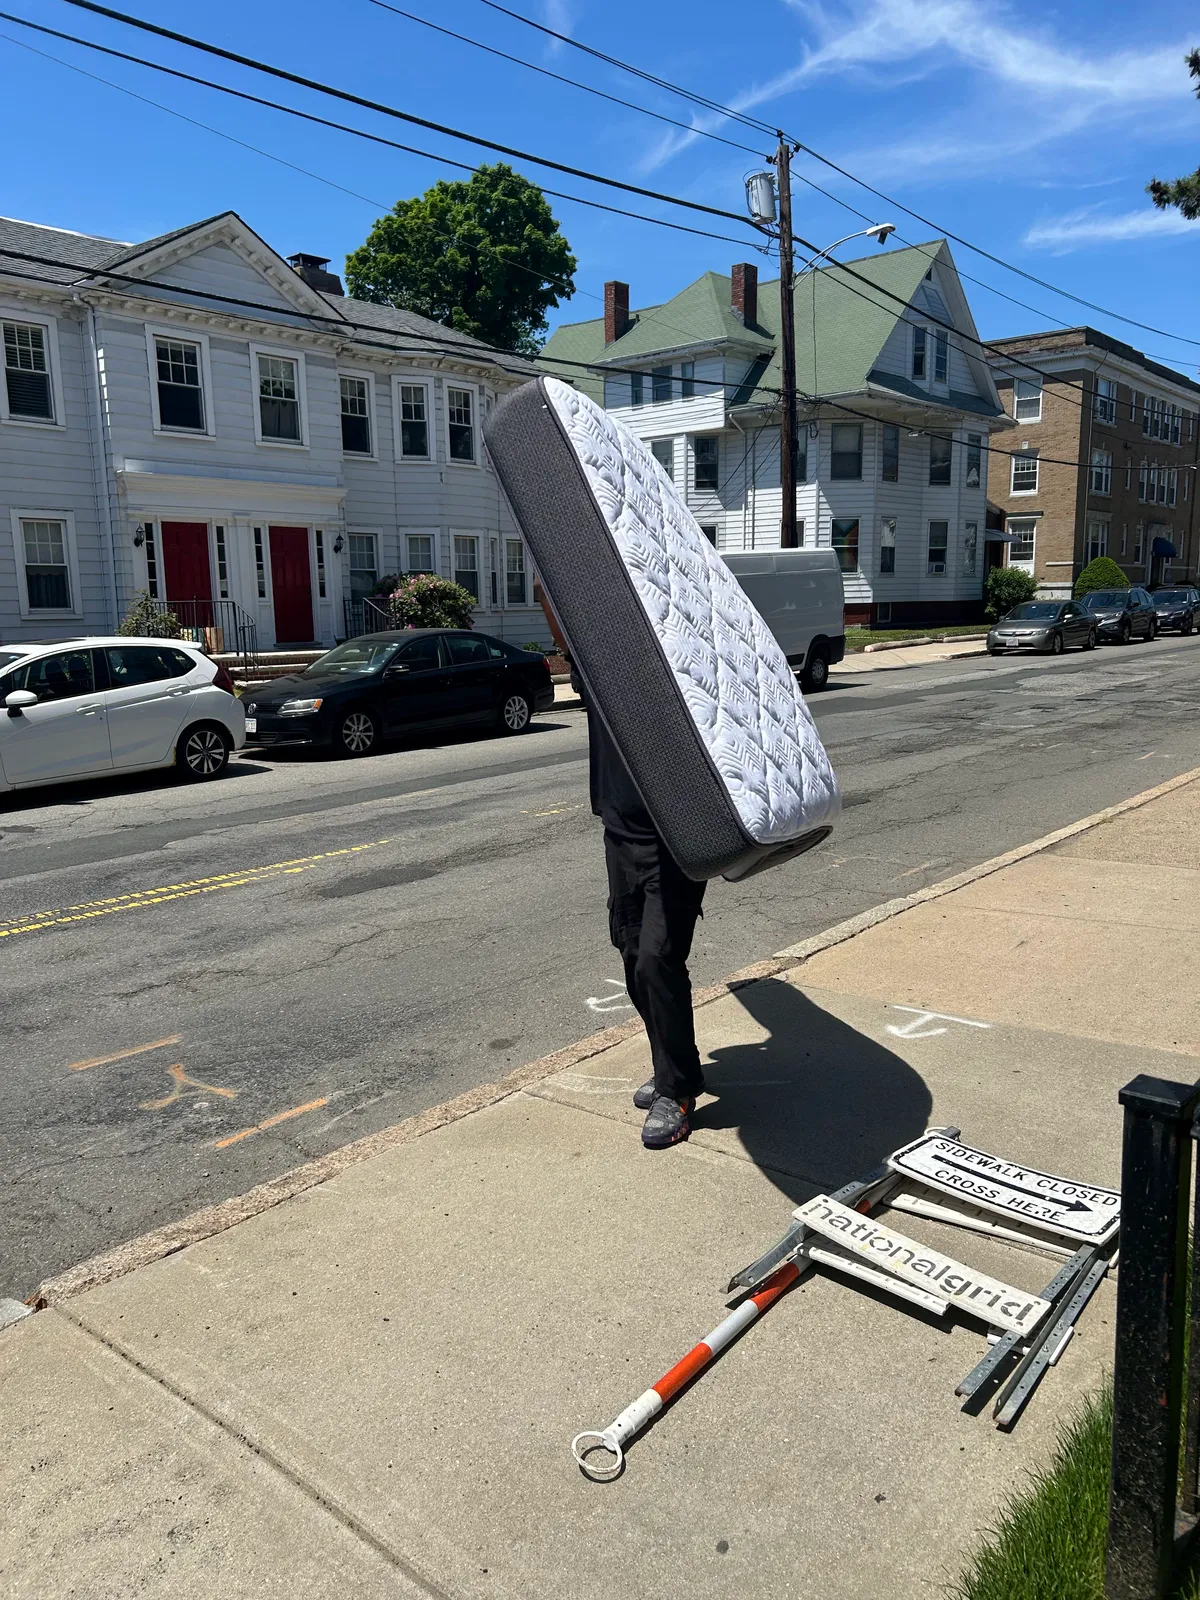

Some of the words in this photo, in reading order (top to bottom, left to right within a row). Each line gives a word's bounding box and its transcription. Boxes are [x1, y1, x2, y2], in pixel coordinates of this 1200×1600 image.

[935, 1169, 1000, 1199] CROSS
[1007, 1197, 1065, 1222] HERE
[936, 1141, 1028, 1181] SIDEWALK
[1037, 1179, 1118, 1206] CLOSED
[807, 1203, 1034, 1321] nationalgrid
